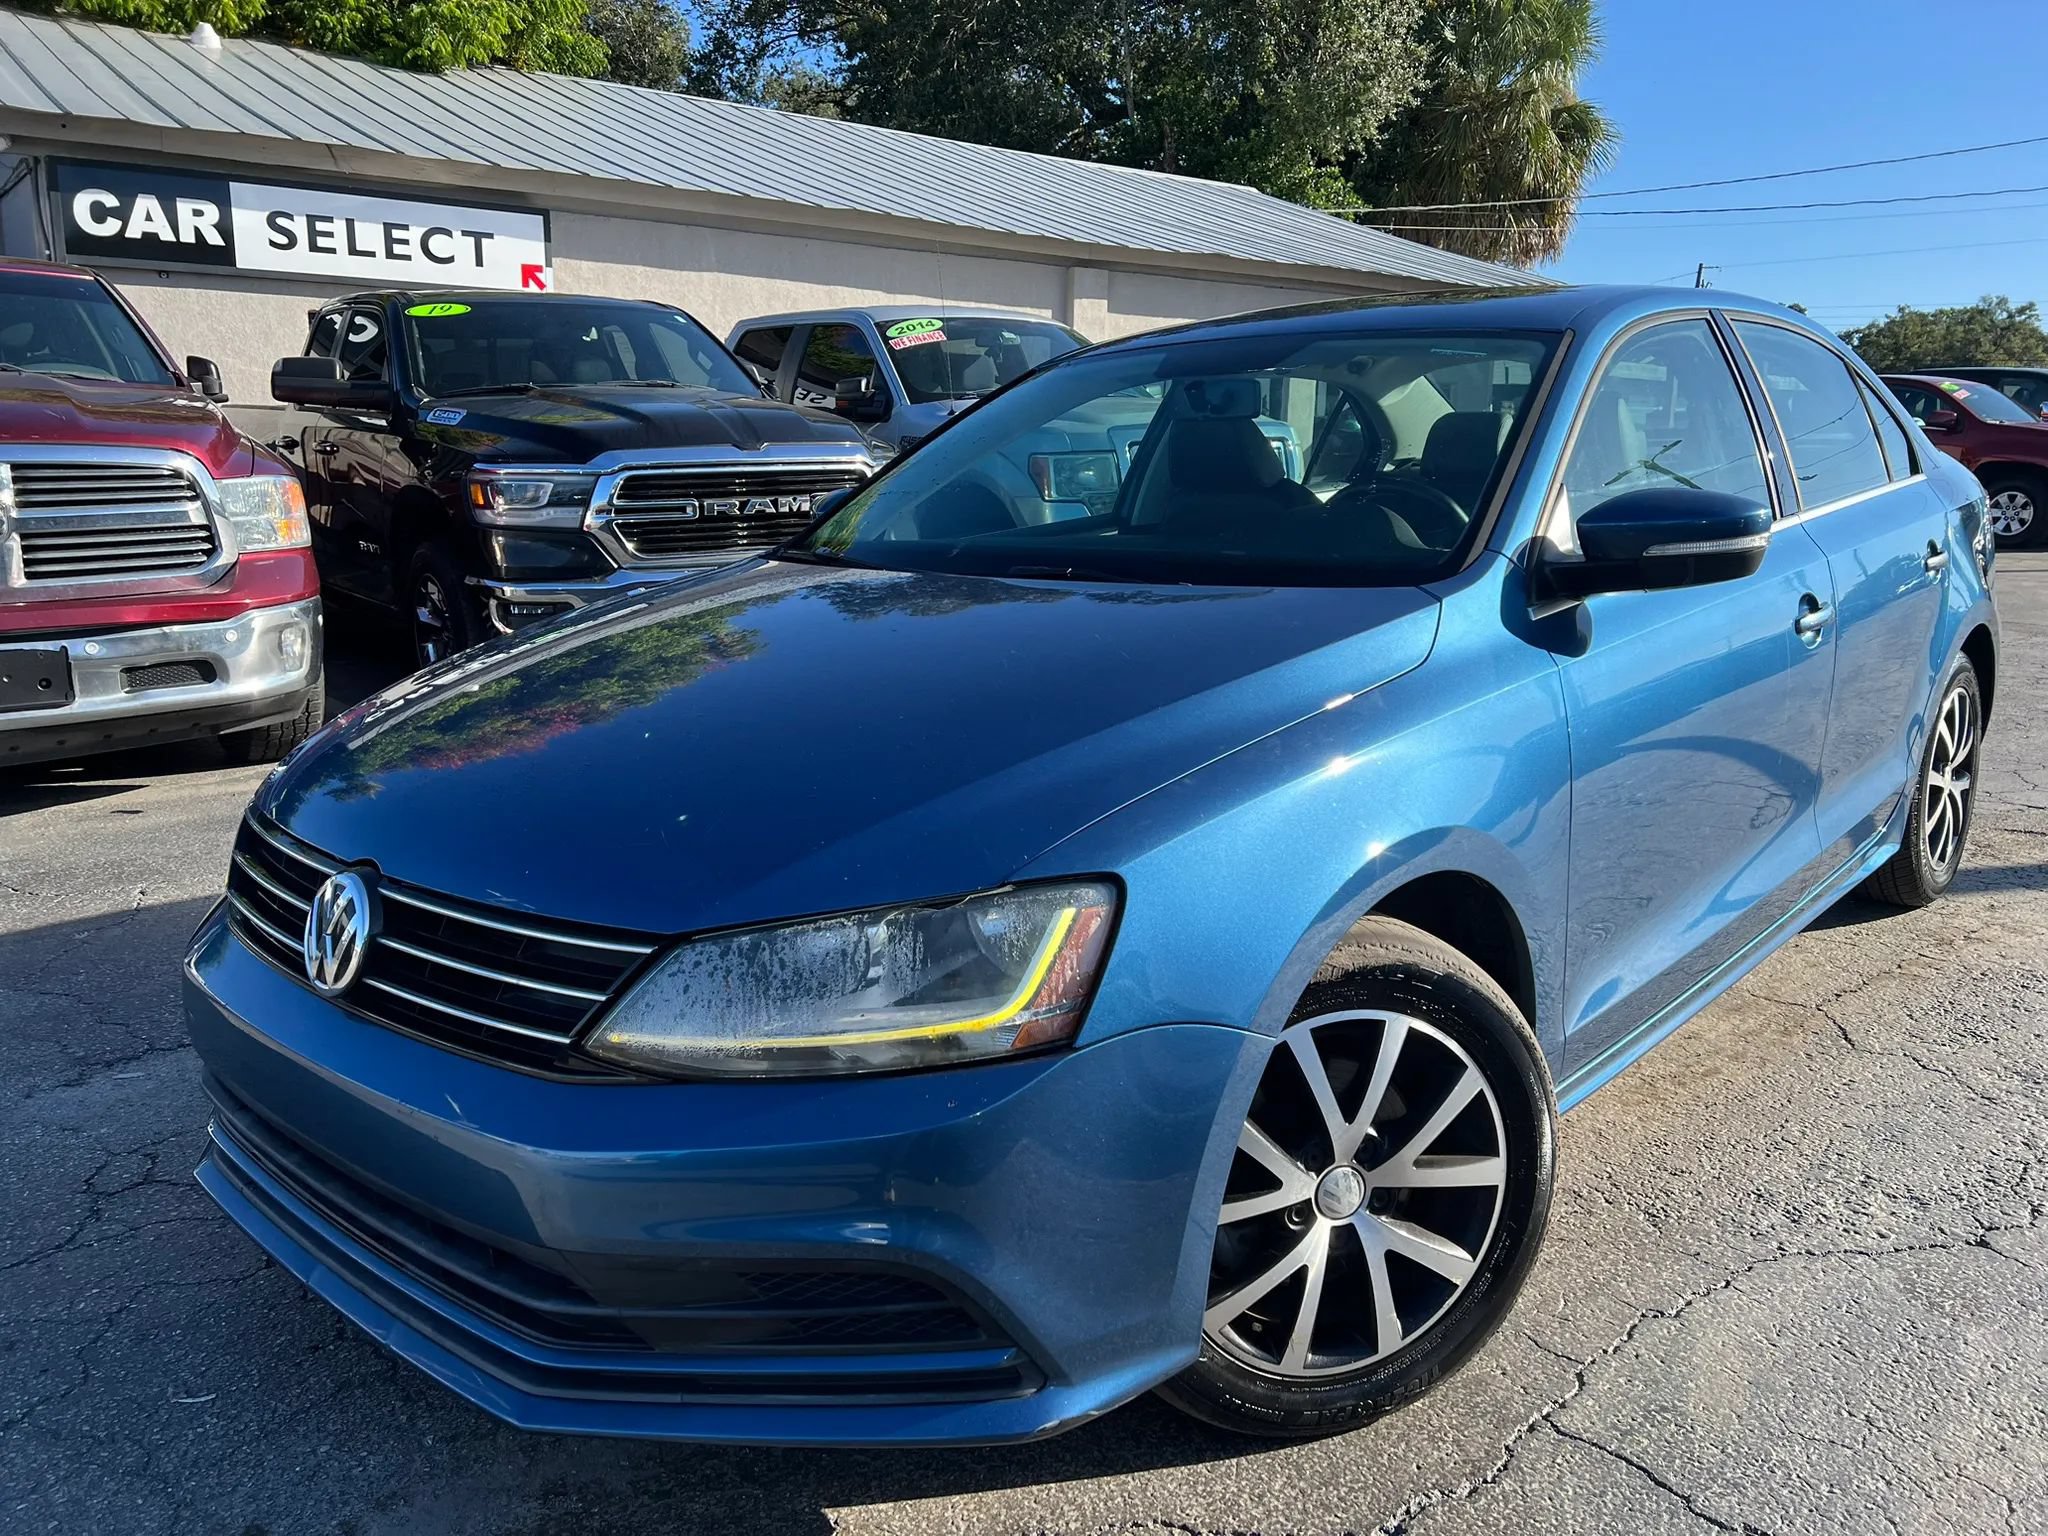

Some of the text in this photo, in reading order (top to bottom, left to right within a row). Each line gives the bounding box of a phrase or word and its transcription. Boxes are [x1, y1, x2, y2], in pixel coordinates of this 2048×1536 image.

[72, 188, 495, 268] CAR SELECT
[427, 305, 453, 315] 19
[895, 320, 935, 335] 2014
[891, 332, 944, 348] WE FINANCE
[703, 494, 811, 516] RAM
